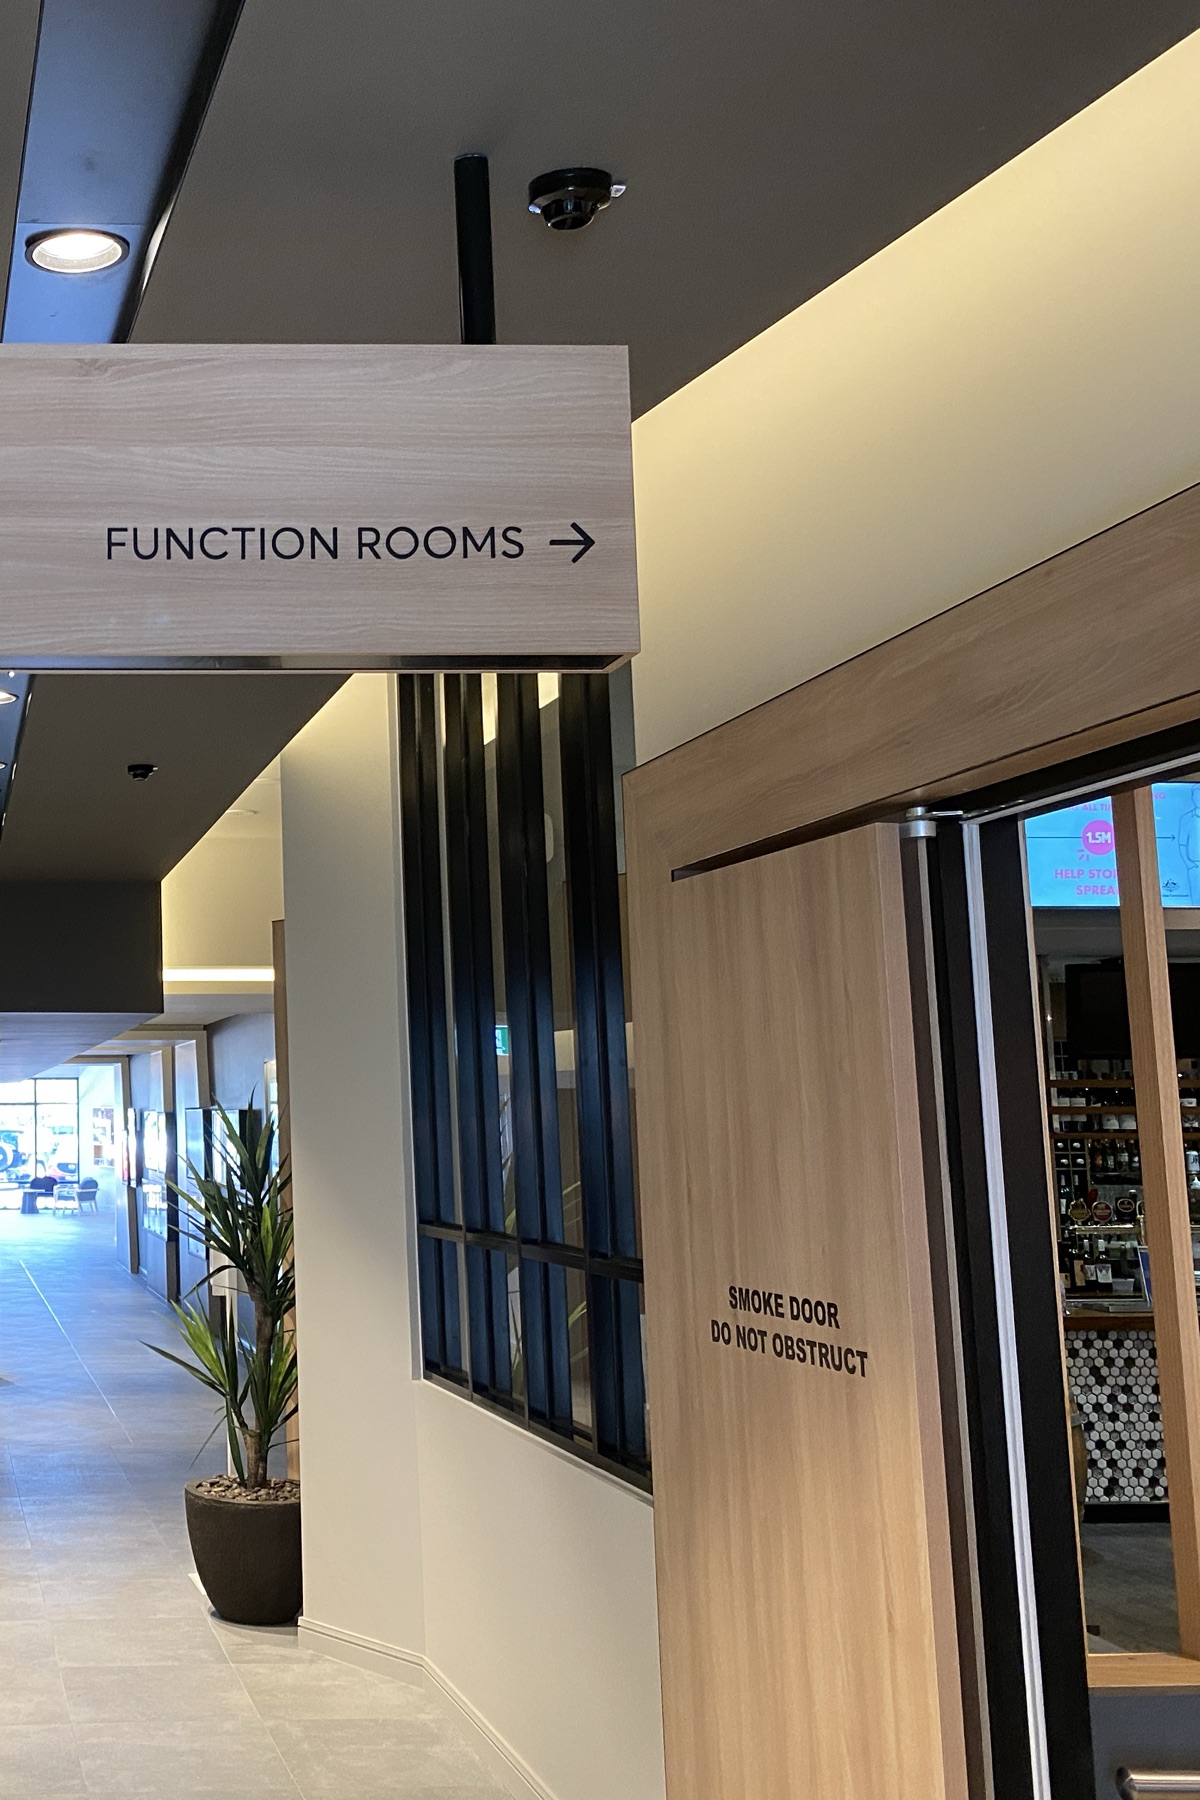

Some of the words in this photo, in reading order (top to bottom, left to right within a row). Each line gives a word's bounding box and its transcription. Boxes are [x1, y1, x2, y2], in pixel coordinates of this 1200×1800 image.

[107, 526, 338, 561] FUNCTION
[357, 525, 525, 560] ROOMS
[1082, 803, 1098, 811] ALL
[1100, 803, 1112, 811] TI
[1086, 832, 1112, 844] 1.5M
[1054, 869, 1085, 879] HELP
[1076, 885, 1119, 895] SPREA
[728, 1285, 785, 1319] SMOKE
[789, 1295, 841, 1330] DOOR
[710, 1319, 732, 1346] DO
[735, 1324, 768, 1354] NOT
[771, 1332, 868, 1378] OBSTRUCT
